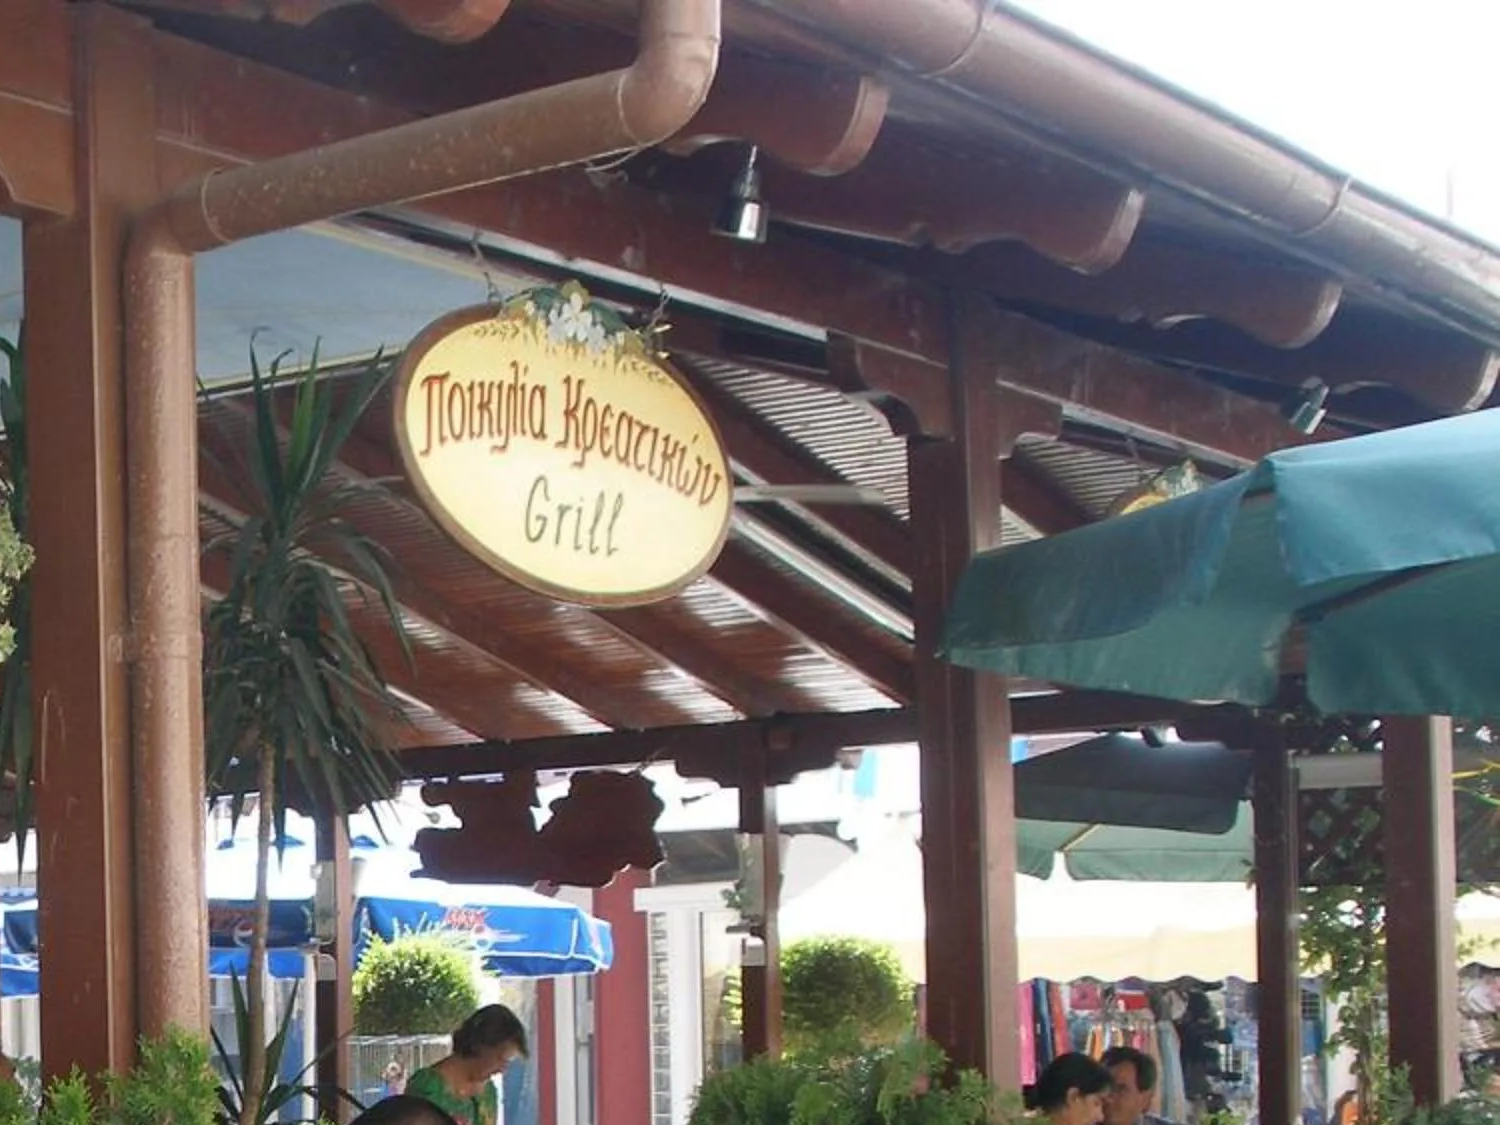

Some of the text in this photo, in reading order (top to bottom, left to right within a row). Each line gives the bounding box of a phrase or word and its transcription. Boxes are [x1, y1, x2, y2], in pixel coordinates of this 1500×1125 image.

[420, 361, 722, 506] Ποικιλία Κρεατικών
[525, 475, 624, 556] Grill
